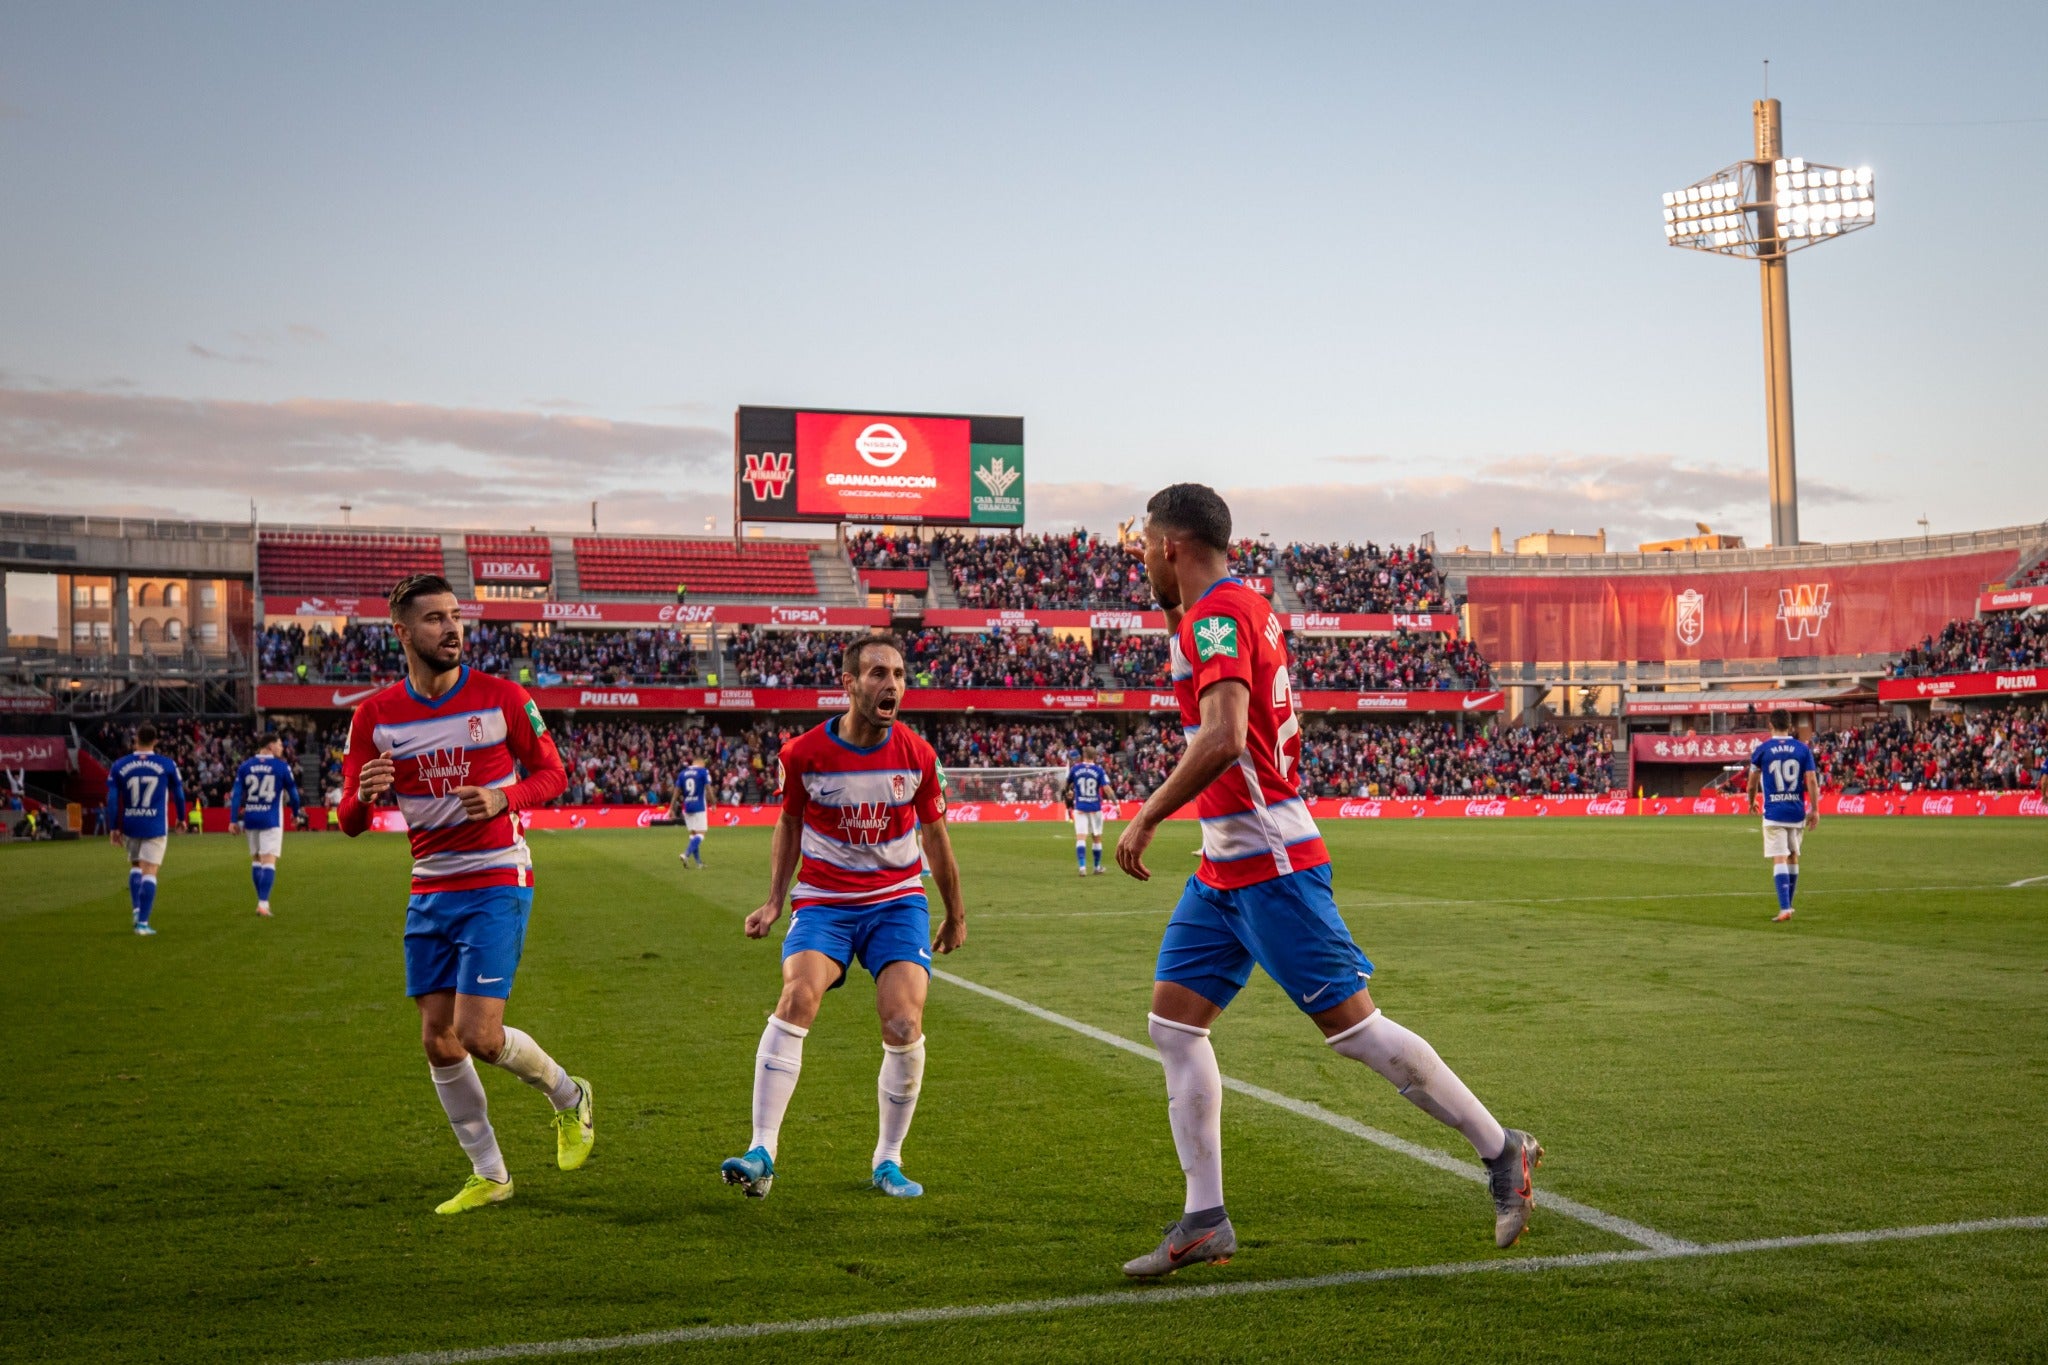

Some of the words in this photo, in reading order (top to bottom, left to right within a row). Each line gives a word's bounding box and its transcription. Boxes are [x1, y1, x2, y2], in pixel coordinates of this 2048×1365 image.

[863, 440, 898, 448] NISSAN
[750, 469, 788, 481] WINAMAX
[826, 473, 937, 490] GRANADAMOCIÓN
[838, 489, 894, 499] CONCESIONARIO
[896, 492, 922, 500] OFICIAL
[974, 496, 994, 504] CAJA
[995, 497, 1022, 505] RURAL
[978, 504, 1018, 512] GRANADA
[481, 562, 541, 576] IDEAL
[2020, 591, 2033, 605] Hoy
[543, 603, 601, 616] IDEAL
[778, 609, 819, 621] TIPSA
[1783, 605, 1825, 617] WINAMAX
[1090, 614, 1142, 628] LEYVA
[1996, 675, 2037, 690] PULEVA
[580, 691, 639, 705] PULEVA
[720, 690, 754, 698] CERVEZAS
[1770, 744, 1796, 754] MANU
[423, 763, 465, 778] WINAMAX
[1768, 758, 1800, 792] 19
[126, 775, 159, 808] 17
[244, 774, 276, 803] 24
[685, 777, 695, 797] 9
[1077, 777, 1098, 797] 18
[844, 818, 884, 830] WINAMAX
